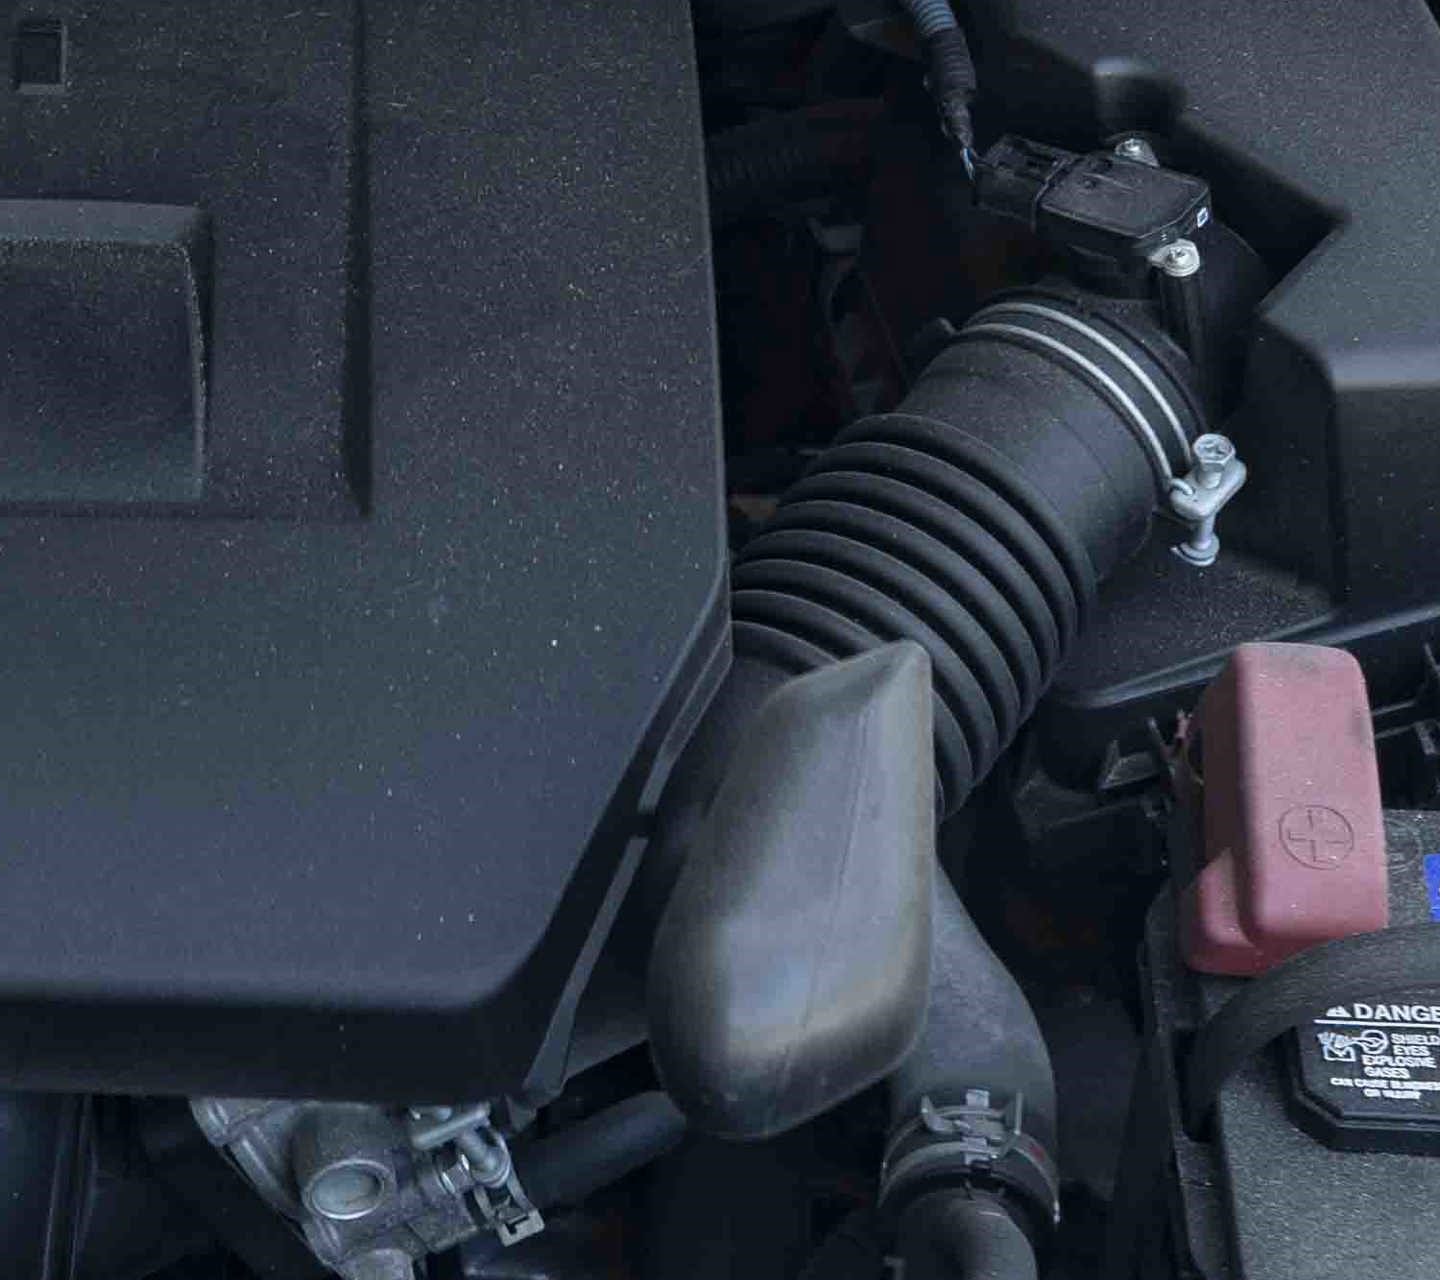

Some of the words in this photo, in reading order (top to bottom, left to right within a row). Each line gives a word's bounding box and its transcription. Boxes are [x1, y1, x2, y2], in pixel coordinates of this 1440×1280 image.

[1393, 1046, 1430, 1057] EYES
[1361, 1054, 1437, 1068] EXPLOSIVE
[1364, 1067, 1410, 1079] GASES
